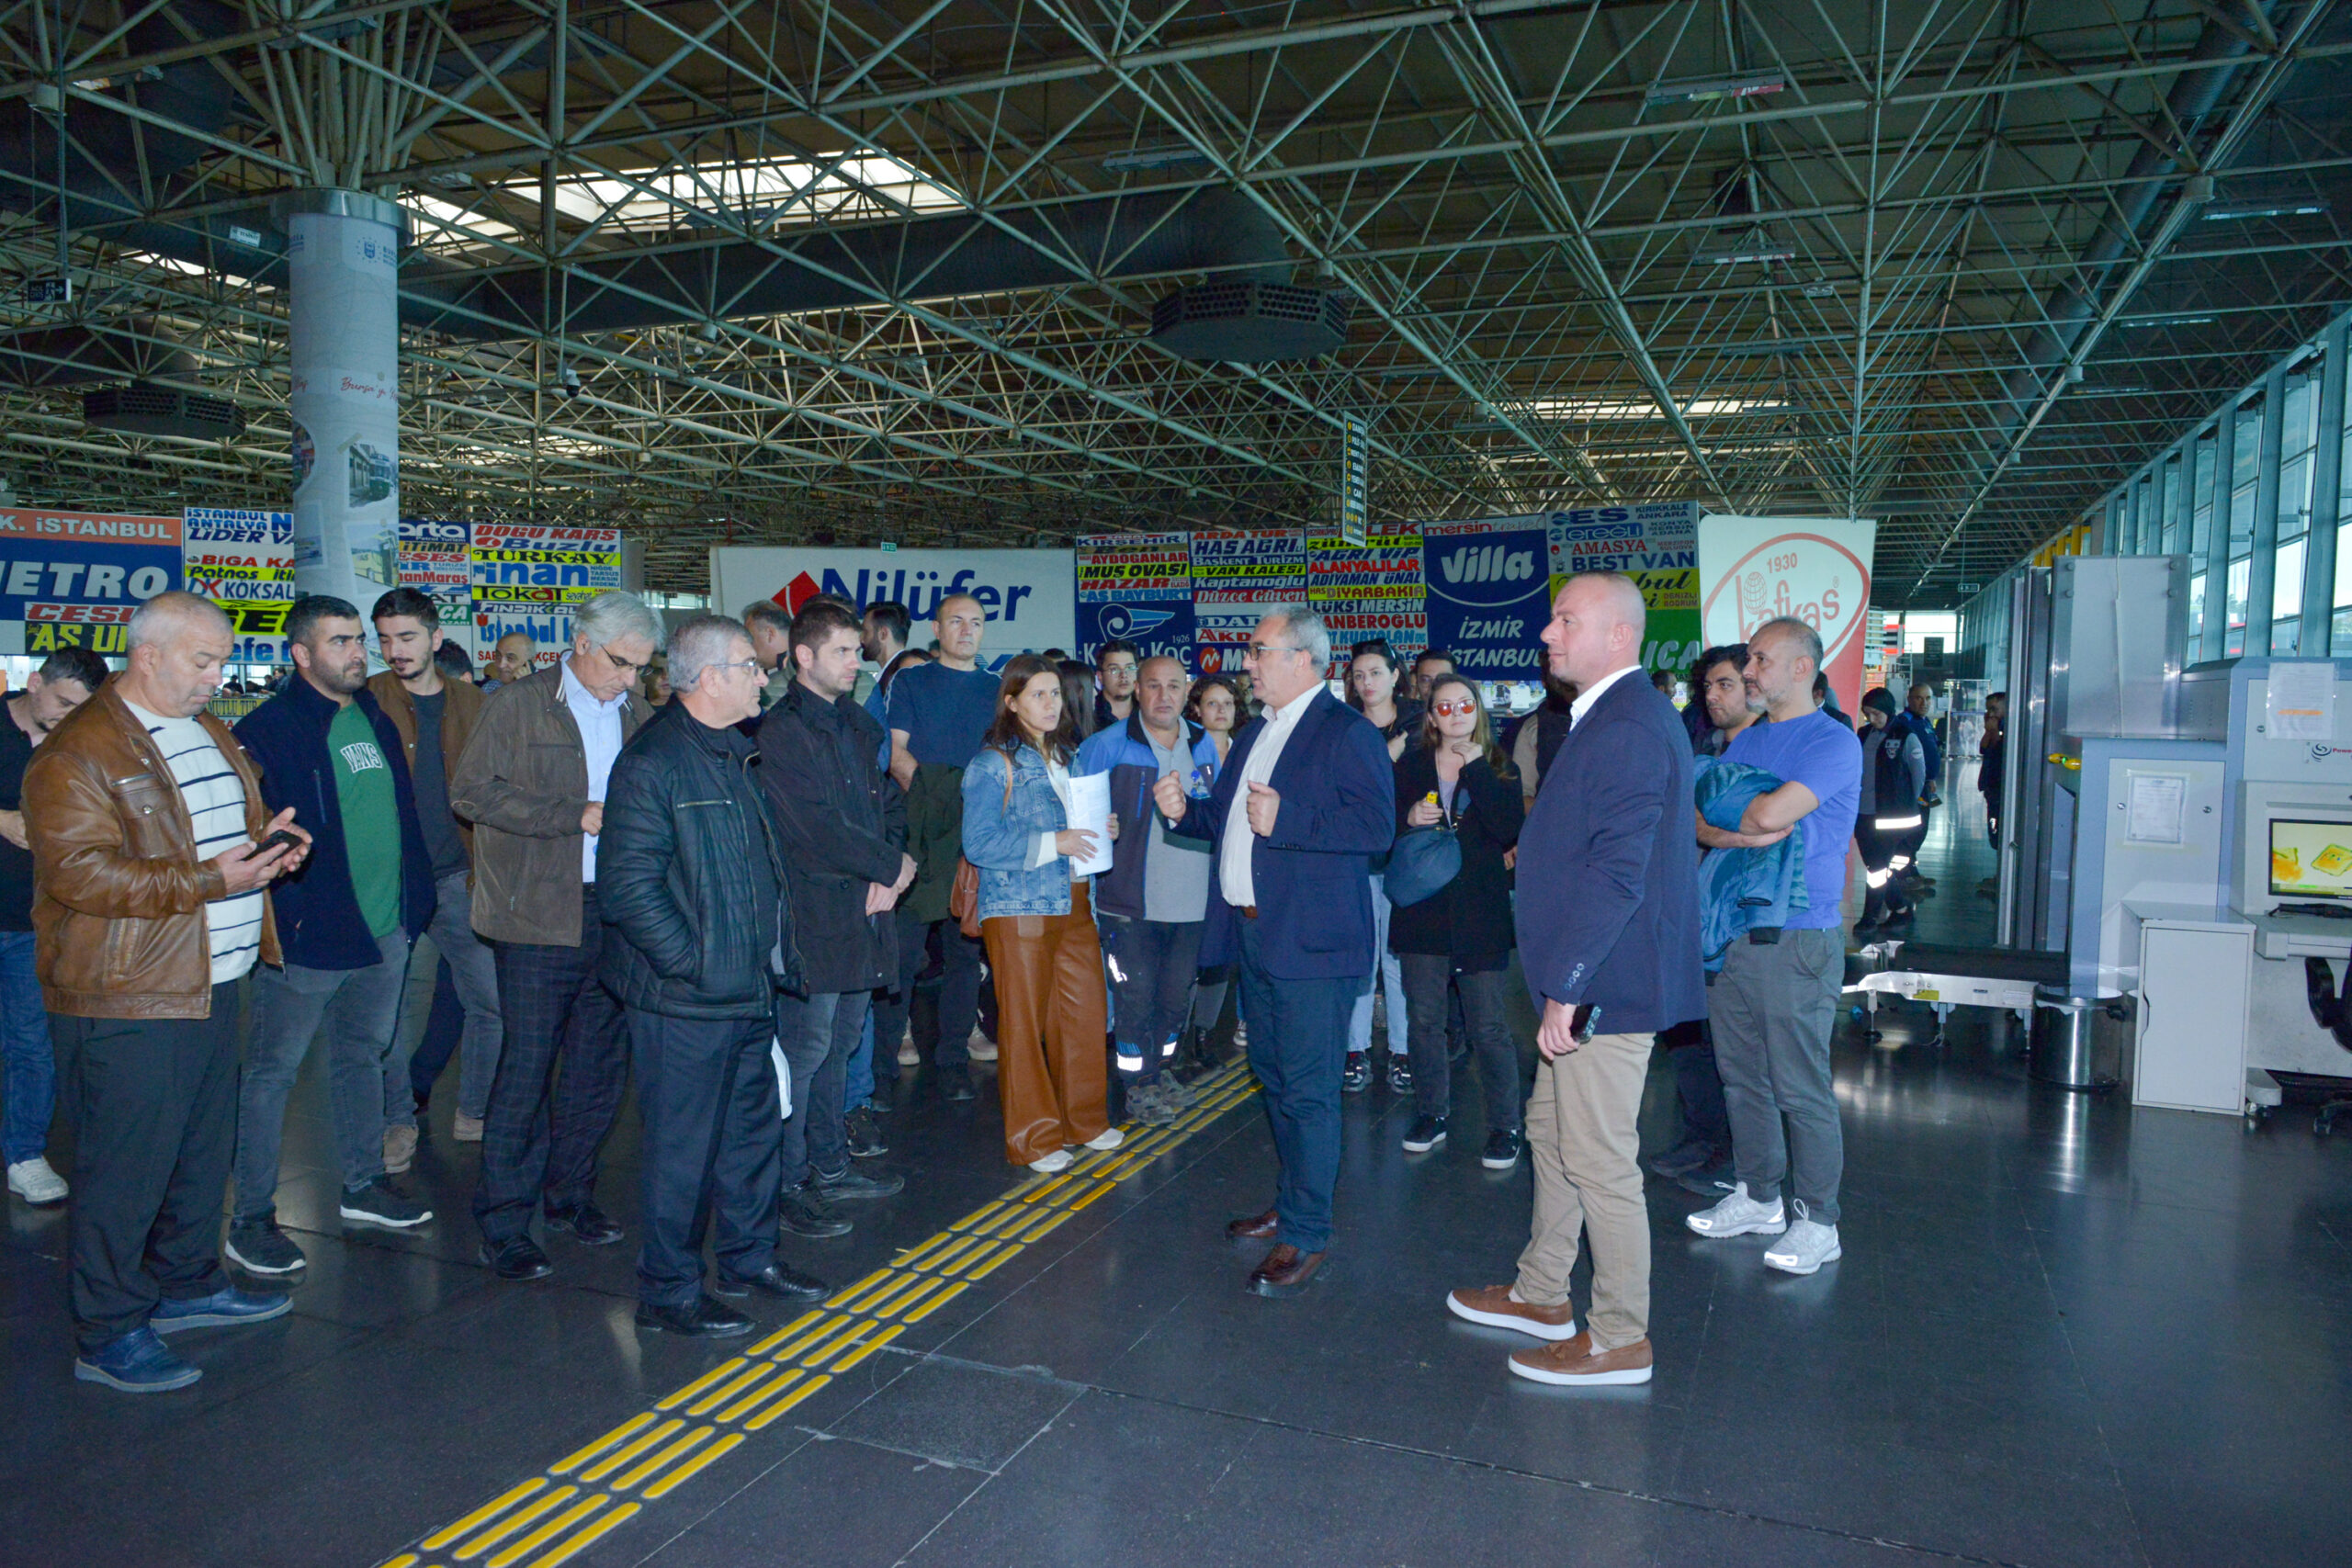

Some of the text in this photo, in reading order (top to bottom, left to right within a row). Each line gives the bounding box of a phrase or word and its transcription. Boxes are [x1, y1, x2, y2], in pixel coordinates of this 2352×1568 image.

[187, 517, 268, 532] ANTALYA
[1424, 521, 1493, 536] mersin
[549, 528, 618, 541] KARS
[1193, 530, 1247, 540] ARDA
[1250, 529, 1288, 538] TUR
[502, 537, 617, 553] Buzlu
[1194, 540, 1238, 555] HAS
[1572, 539, 1648, 556] AMASYA
[1308, 558, 1420, 574] ALANYALILAR
[1441, 545, 1535, 584] Villa
[1572, 551, 1695, 572] BEST VAN
[1767, 552, 1798, 574] 1930
[189, 566, 259, 580] Patnos
[1206, 567, 1241, 575] VAN
[0, 559, 169, 601] ETRO
[1080, 578, 1170, 591] HAZAR
[1194, 575, 1306, 590] Kaptanoğlu
[1310, 573, 1380, 586] ADIYAMAN
[820, 568, 1033, 622] Nilüfer
[1111, 589, 1191, 601] BAYBURT
[1196, 589, 1307, 604] Düzce Güven
[1458, 615, 1524, 639] İZMİR
[1172, 634, 1191, 645] 1926
[339, 741, 383, 773] VANS
